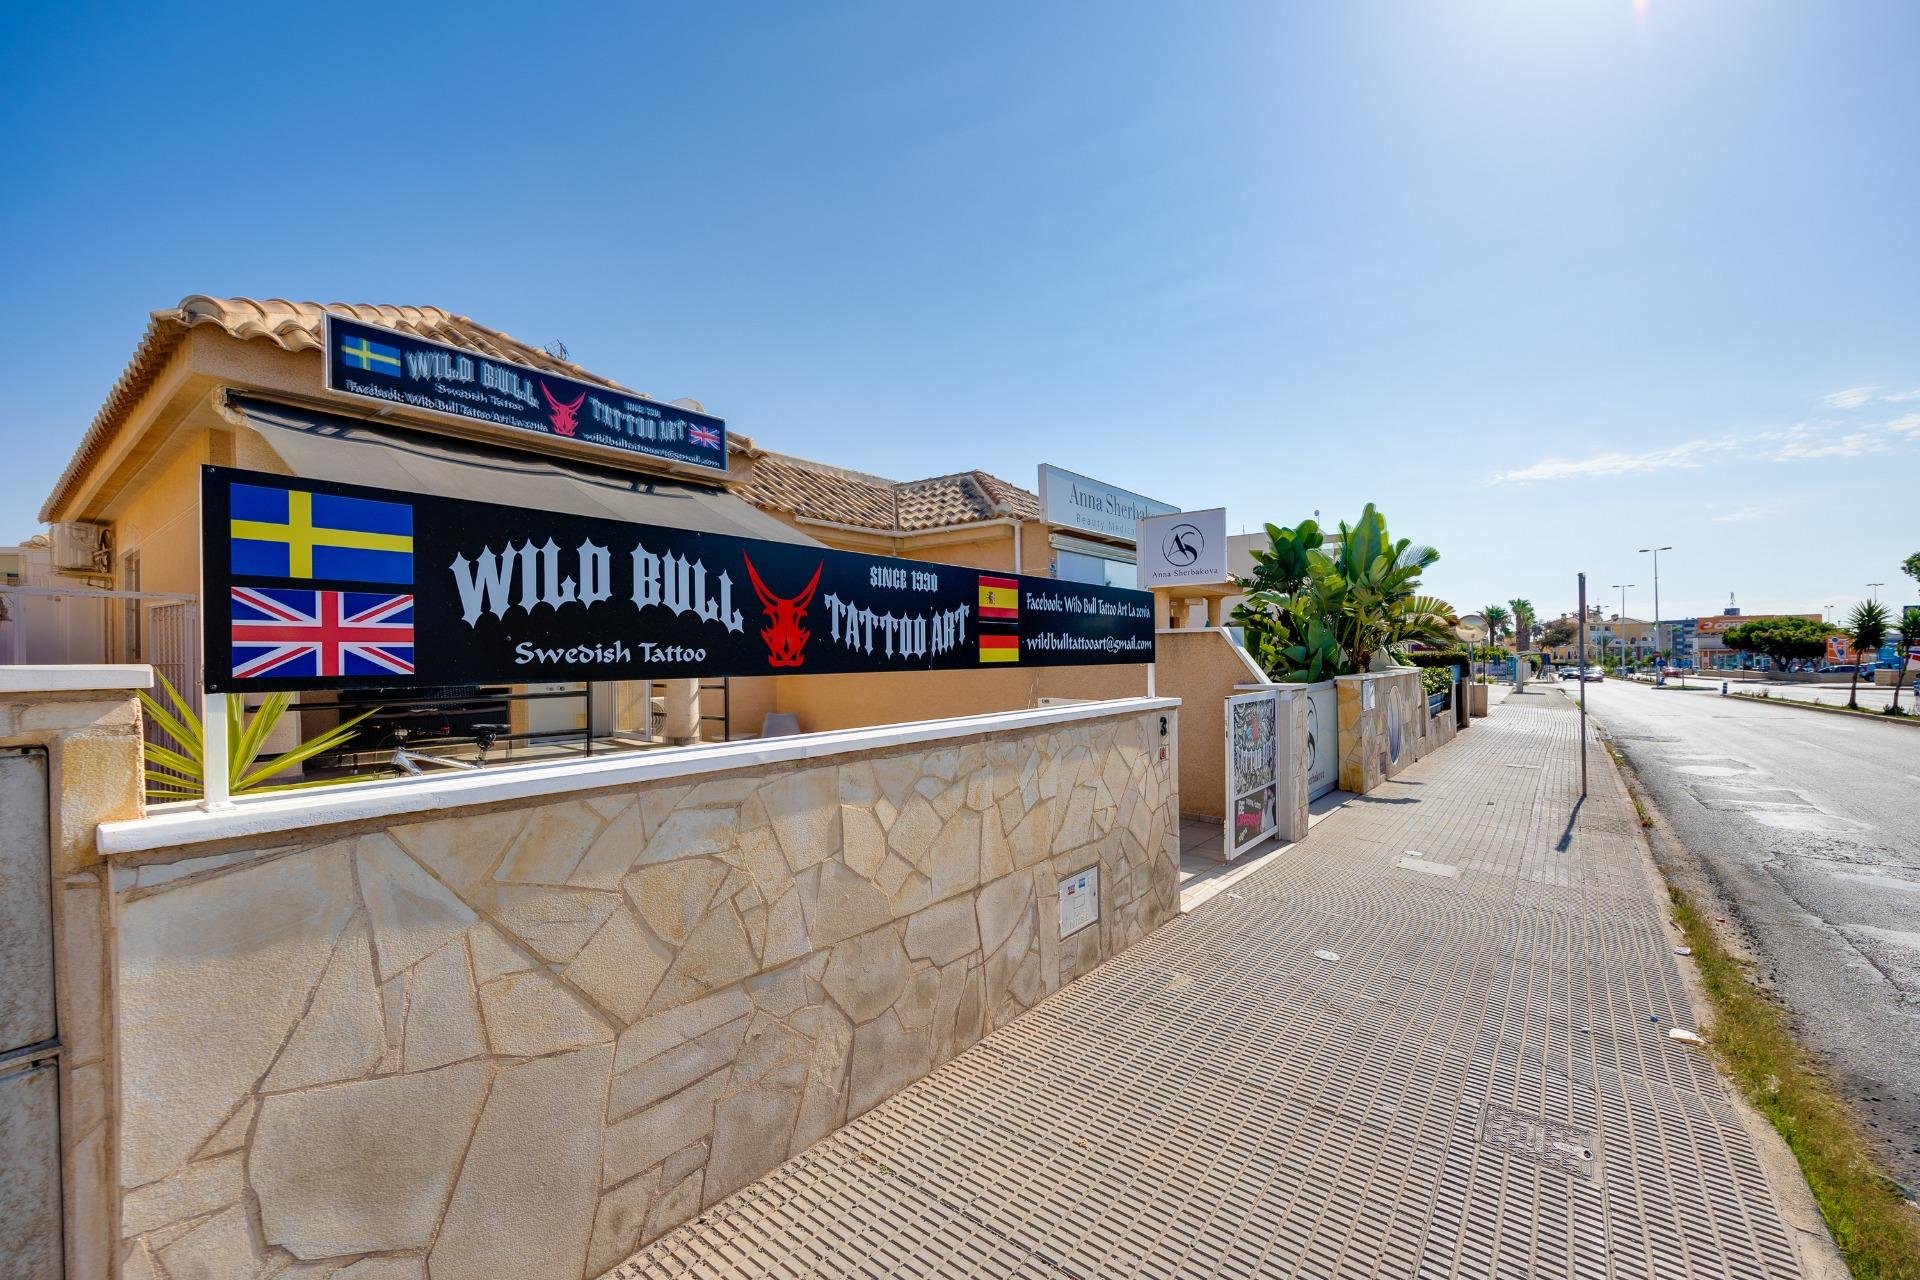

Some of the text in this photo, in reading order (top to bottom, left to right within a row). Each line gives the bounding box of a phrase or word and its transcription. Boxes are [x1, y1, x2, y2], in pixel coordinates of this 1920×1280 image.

[405, 350, 540, 409] WILD BULL
[434, 382, 524, 411] Swedish Tattoo
[588, 395, 687, 443] TATTOO ART
[1070, 481, 1103, 511] Anna
[1076, 513, 1105, 530] Beauty
[448, 536, 745, 634] WILD BULL
[869, 564, 908, 591] SINCE
[1152, 568, 1218, 579] Anna Sherbakova
[1026, 592, 1063, 612] Facebook:
[1064, 595, 1082, 613] Wild
[1083, 597, 1097, 615] Bull
[1098, 599, 1116, 616] Tattoo
[1117, 601, 1128, 616] Art
[824, 592, 970, 660] TATTOO ART
[515, 641, 707, 664] Swedish Tattoo
[1159, 716, 1168, 736] 3
